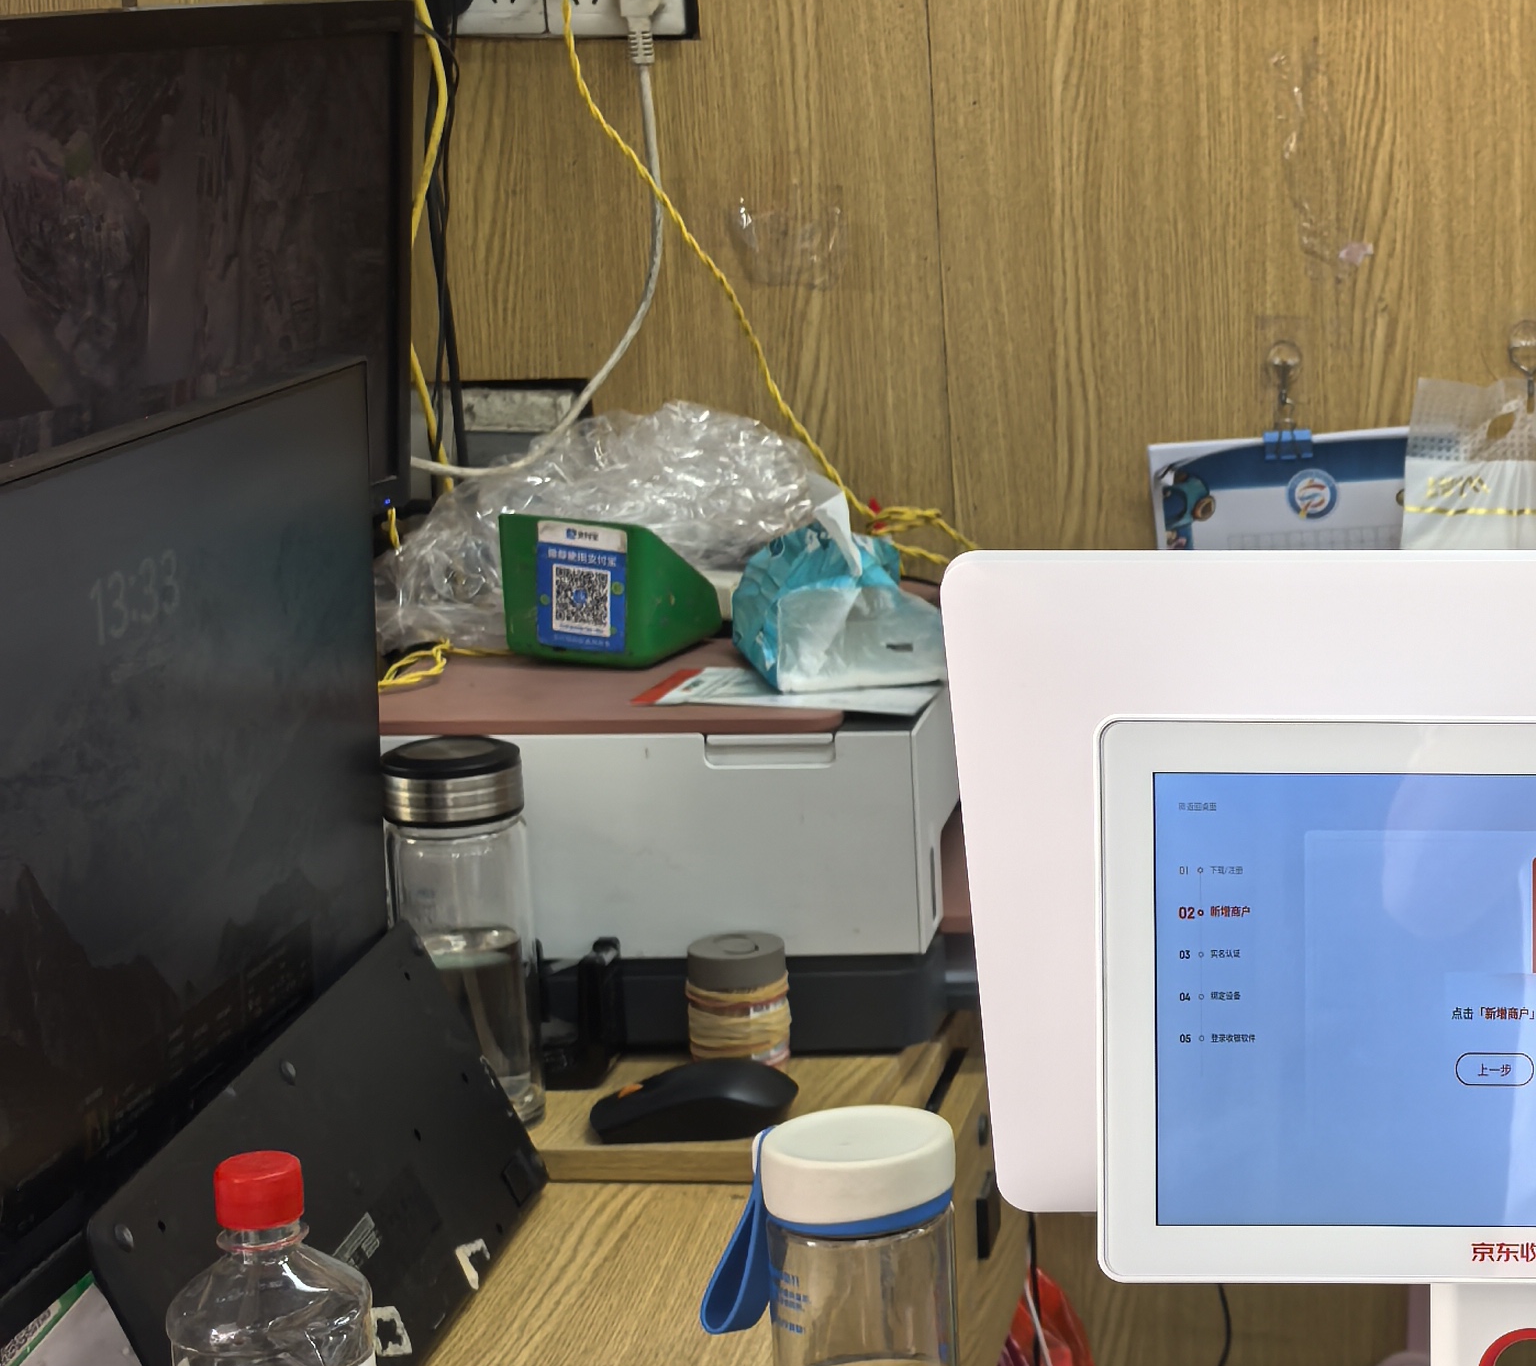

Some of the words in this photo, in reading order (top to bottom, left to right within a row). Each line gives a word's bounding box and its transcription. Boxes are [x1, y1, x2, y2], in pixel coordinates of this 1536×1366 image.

[88, 549, 182, 647] 13:33
[1178, 906, 1196, 920] 02
[1179, 950, 1192, 960] 03
[1209, 949, 1242, 959] 实名认证
[1179, 992, 1192, 1002] 04
[1179, 1033, 1192, 1043] 05
[1477, 1062, 1513, 1078] 上一步
